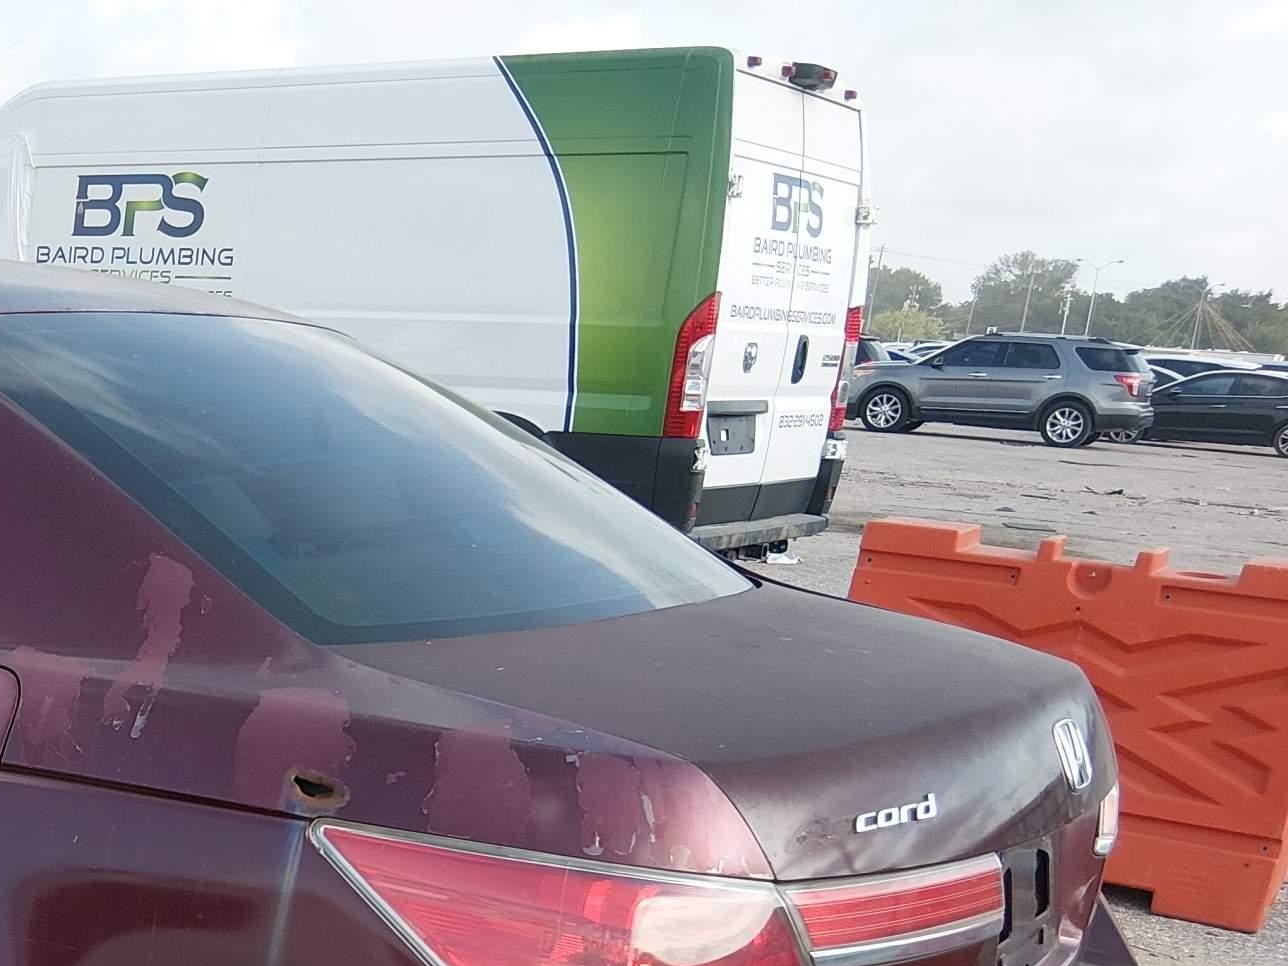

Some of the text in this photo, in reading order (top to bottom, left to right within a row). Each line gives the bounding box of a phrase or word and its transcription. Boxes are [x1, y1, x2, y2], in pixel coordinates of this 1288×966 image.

[72, 171, 209, 238] BPS
[771, 172, 824, 238] BPS
[36, 245, 234, 266] BAIRD PLUMBING
[753, 237, 832, 264] BAIRD PLUMBING
[855, 792, 938, 834] cord
